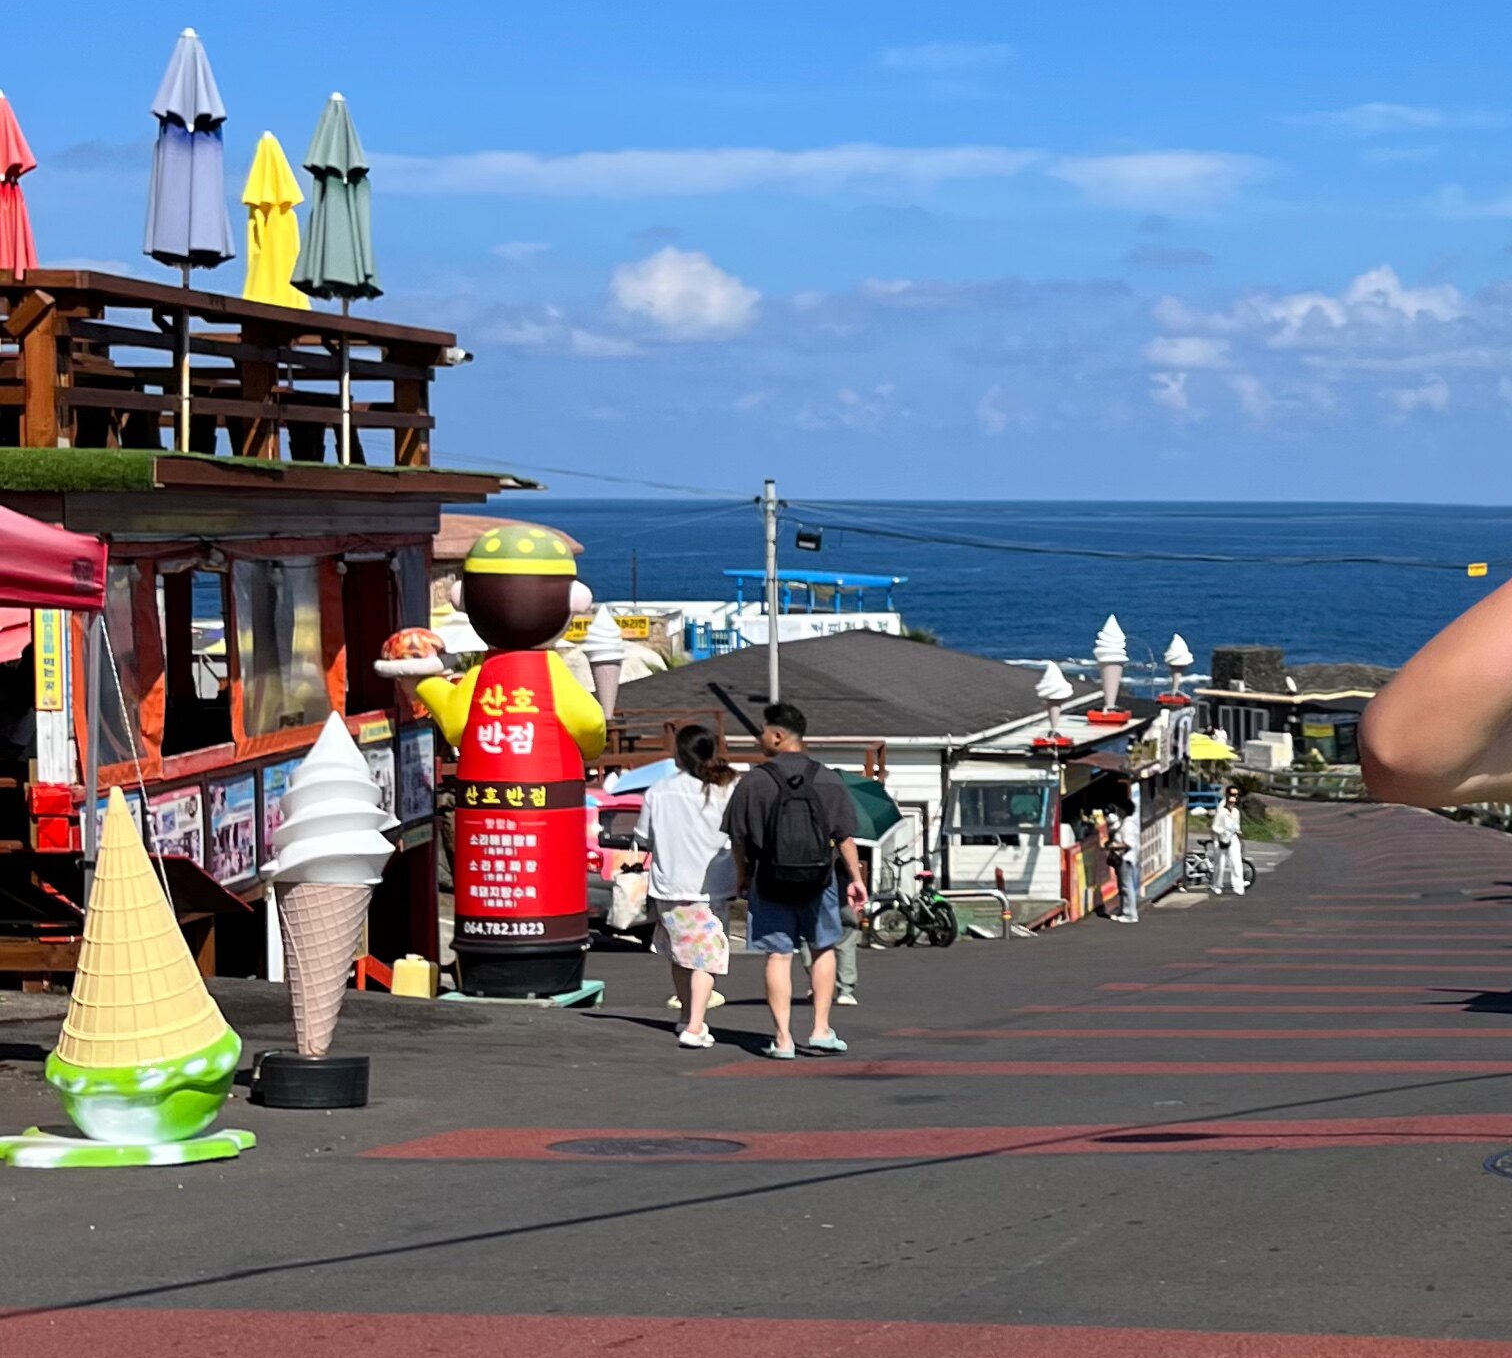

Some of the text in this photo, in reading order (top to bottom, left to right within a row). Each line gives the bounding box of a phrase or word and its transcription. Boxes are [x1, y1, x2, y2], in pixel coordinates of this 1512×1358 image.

[480, 683, 540, 717] 산호
[477, 721, 535, 754] 반점
[463, 921, 545, 936] 064.782.1823
